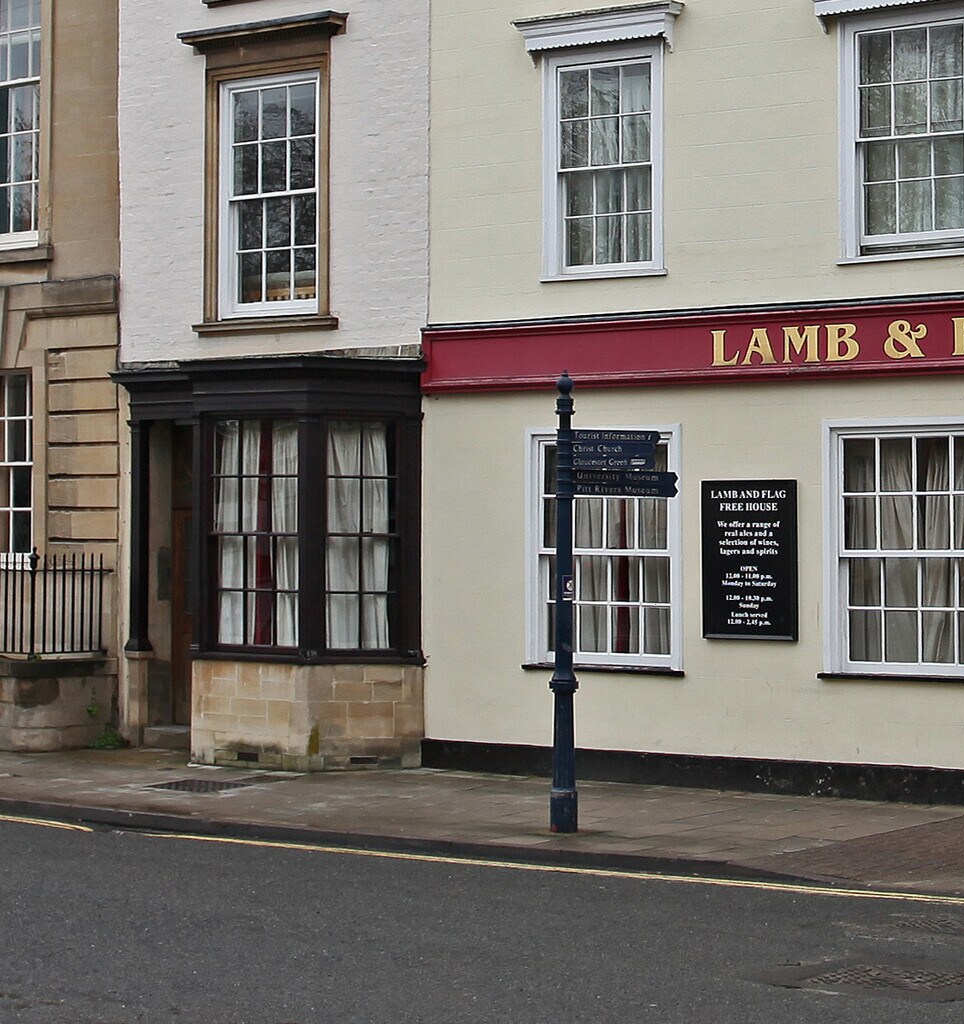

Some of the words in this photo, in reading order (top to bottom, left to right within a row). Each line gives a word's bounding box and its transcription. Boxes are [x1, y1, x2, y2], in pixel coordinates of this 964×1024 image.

[710, 322, 861, 367] LAMB
[882, 319, 928, 360] &
[574, 431, 600, 440] Tourist
[601, 431, 646, 440] Information
[572, 444, 594, 453] Christ
[597, 444, 623, 453] Church
[573, 458, 607, 466] Gloucester
[608, 458, 628, 466] Green
[576, 472, 620, 482] University
[625, 472, 659, 482] Museum
[576, 484, 592, 493] Pitt
[594, 485, 622, 494] Rivers
[625, 485, 659, 495] Museum
[710, 489, 739, 499] LAMB
[740, 489, 760, 499] AND
[761, 489, 787, 499] FLAG
[719, 502, 744, 512] FREE
[745, 502, 779, 512] HOUSE
[717, 520, 727, 528] We
[728, 520, 745, 528] offer
[772, 520, 781, 528] of
[724, 529, 738, 537] real
[754, 529, 767, 537] and
[719, 538, 748, 546] selection
[749, 538, 757, 546] of
[757, 538, 779, 547] wines,
[719, 547, 741, 556] lagers
[741, 547, 755, 555] and
[756, 547, 779, 556] spirits
[721, 579, 744, 587] Monday
[751, 580, 777, 588] Saturday
